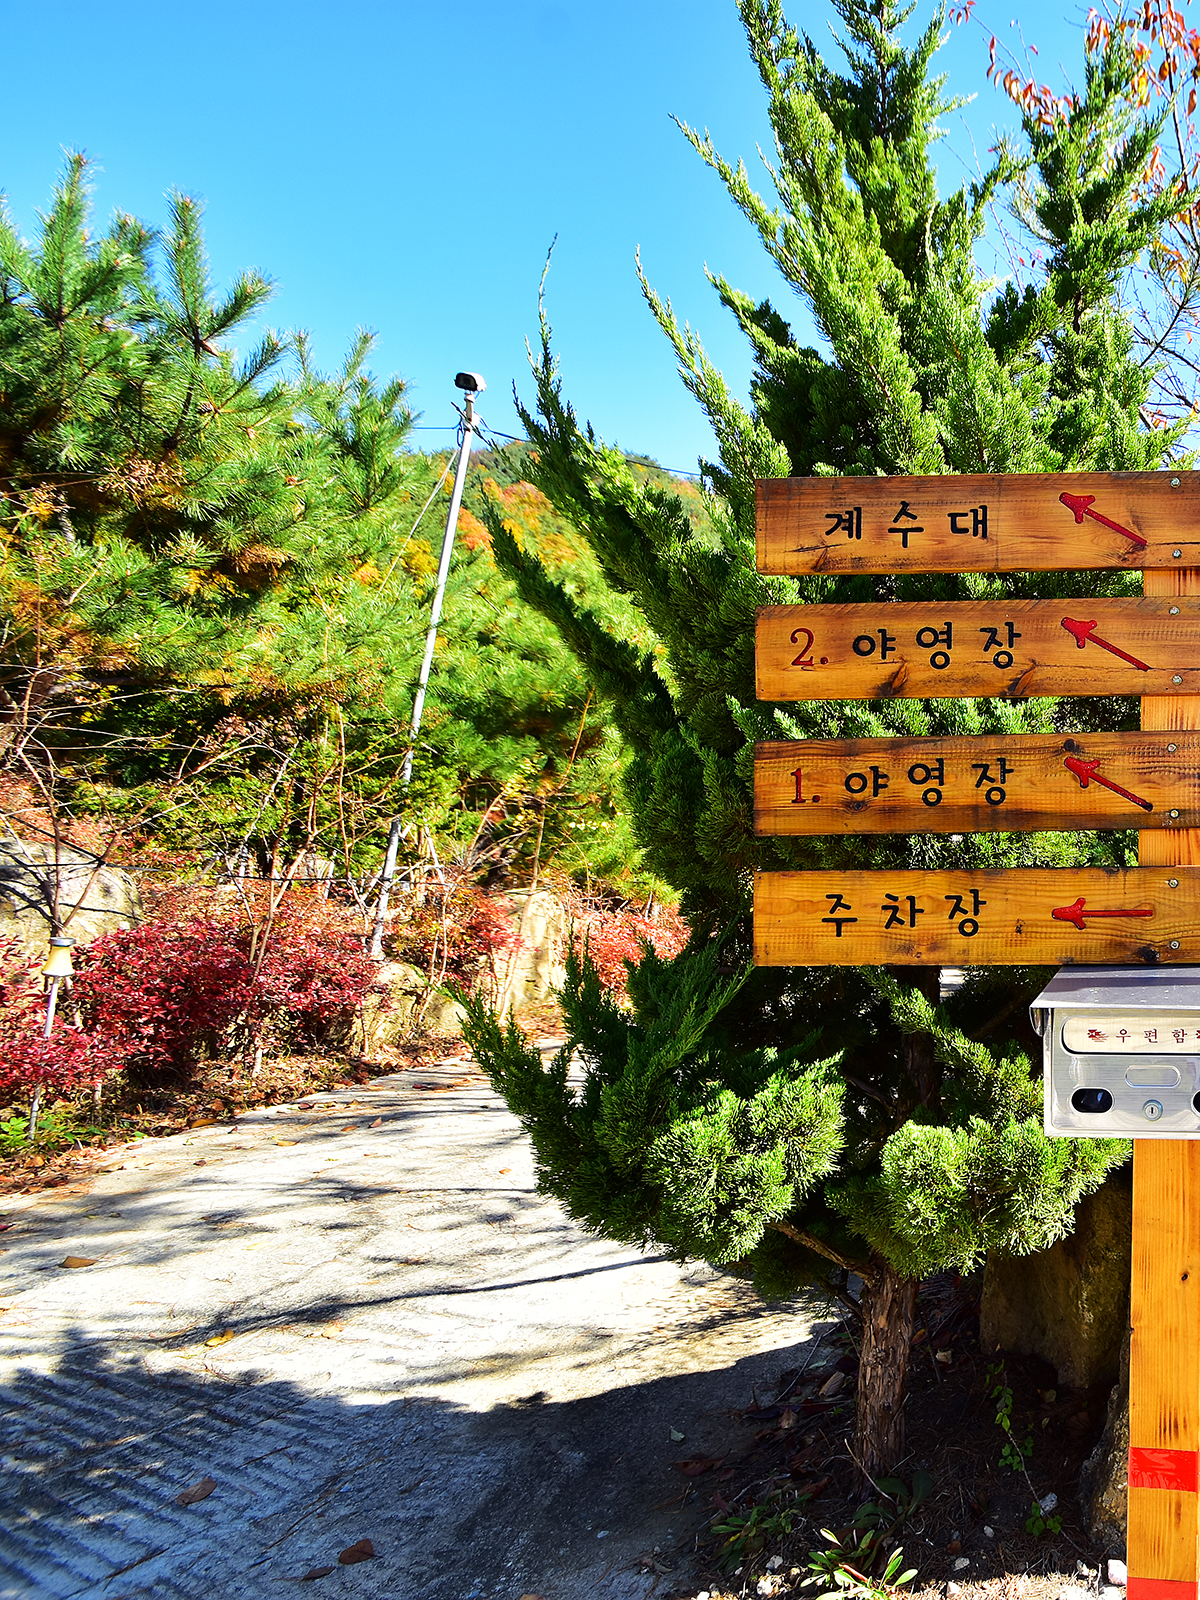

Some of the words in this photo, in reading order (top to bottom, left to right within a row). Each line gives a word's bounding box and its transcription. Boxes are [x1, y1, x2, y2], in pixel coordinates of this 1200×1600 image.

[824, 500, 989, 548] 계수대
[789, 627, 830, 667] 2.
[851, 621, 1022, 670] 야영장
[790, 767, 822, 804] 1.
[844, 757, 1015, 807] 야영장
[821, 888, 988, 938] 주차장
[1115, 1028, 1188, 1044] 우편함
